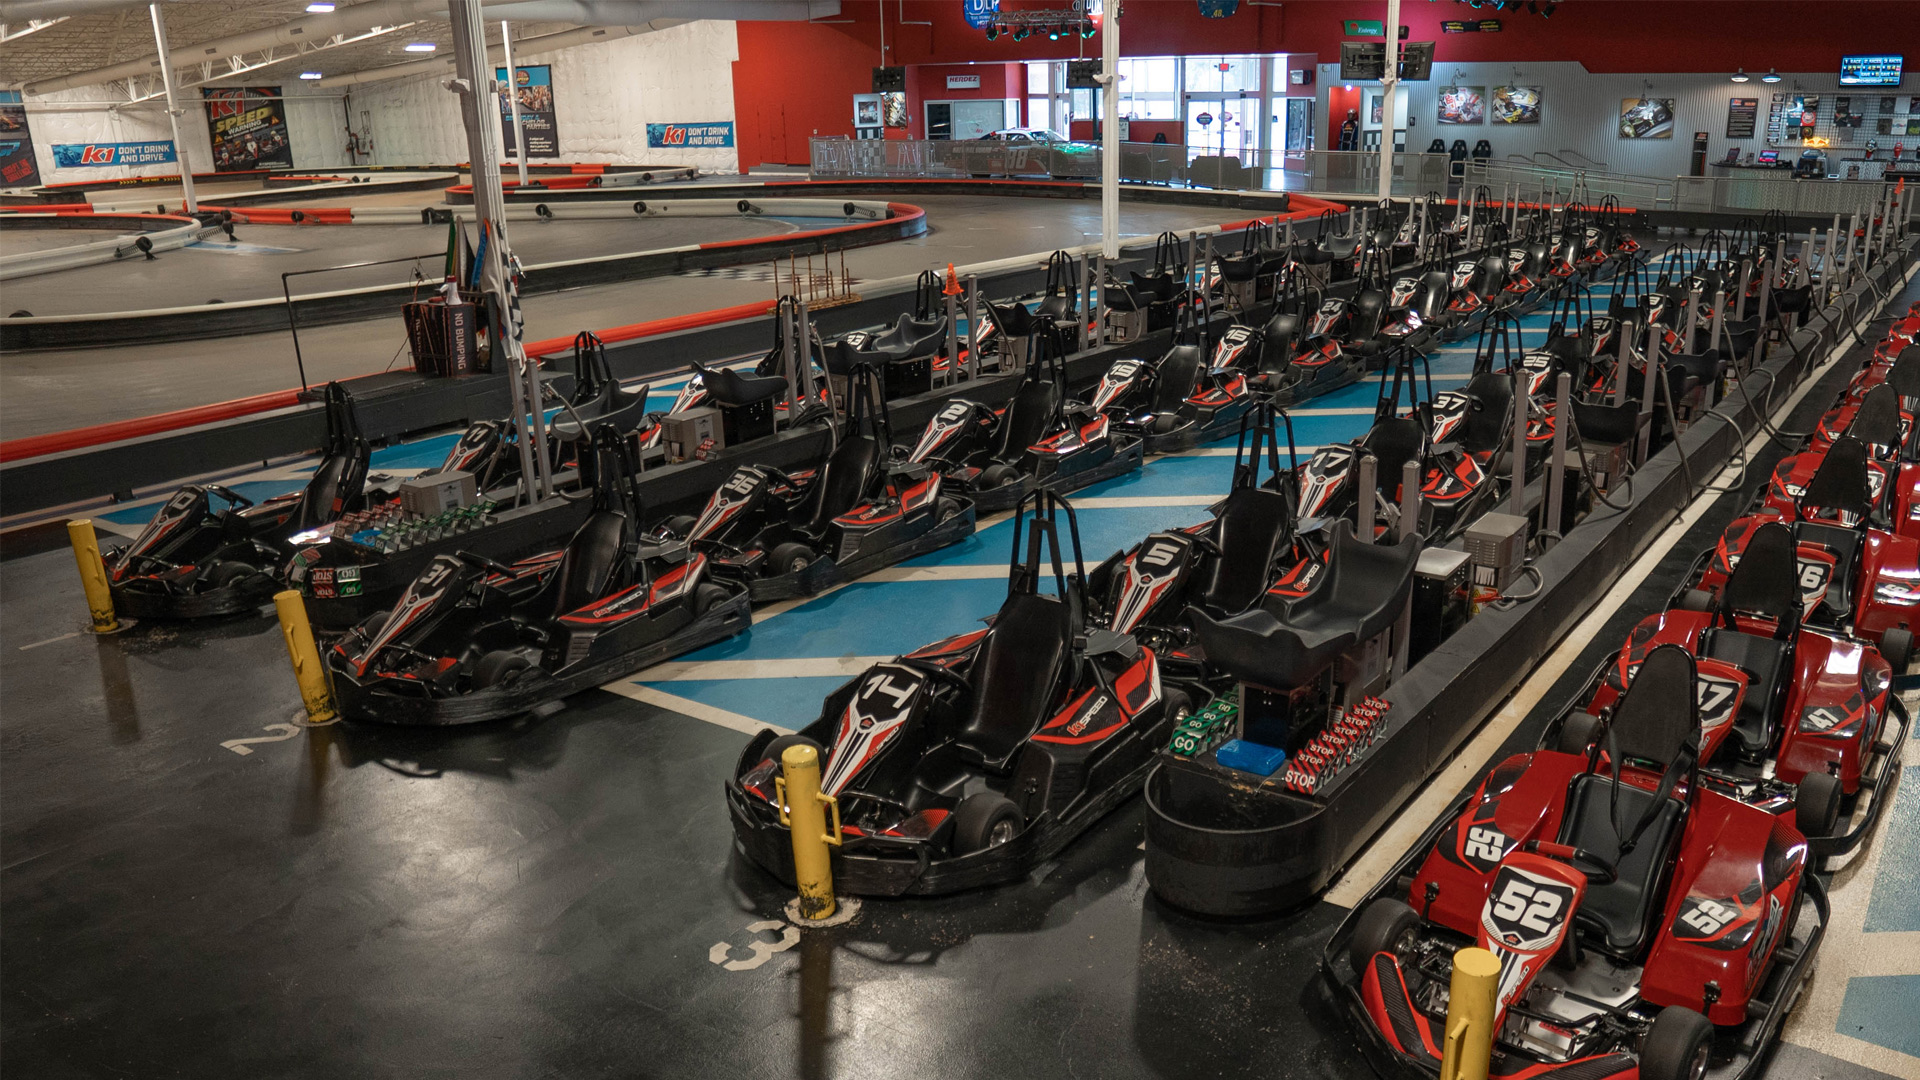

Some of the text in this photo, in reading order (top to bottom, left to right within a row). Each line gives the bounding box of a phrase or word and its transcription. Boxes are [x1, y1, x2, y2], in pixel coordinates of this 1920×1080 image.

[208, 90, 245, 120] K1
[216, 107, 274, 132] SPEED
[228, 120, 261, 135] WARNING
[662, 125, 686, 144] K1
[688, 127, 729, 136] DON'T DRINK
[688, 137, 702, 145] AND
[81, 145, 115, 164] K1
[118, 145, 170, 155] DON'T DRINK
[120, 153, 166, 163] AND DRIVE.
[1457, 264, 1474, 272] 12
[1321, 301, 1342, 312] 24
[455, 313, 466, 370] NO BUMPING
[1225, 329, 1250, 342] 16
[1523, 356, 1552, 367] 25
[1110, 364, 1137, 377] 19
[1433, 396, 1466, 410] 37
[941, 404, 968, 421] 2
[467, 426, 489, 443] 11
[1313, 452, 1351, 468] 17
[724, 472, 759, 494] 36
[168, 492, 197, 510] 10
[376, 540, 384, 549] GO
[1142, 543, 1180, 566] 5
[420, 564, 452, 587] 31
[1798, 564, 1824, 589] 6
[593, 590, 643, 618] K1SPEED
[862, 674, 919, 709] 14
[1218, 703, 1231, 713] GO
[1364, 699, 1387, 710] STOP
[1067, 695, 1108, 736] K1SPEED
[1203, 712, 1216, 721] GO
[1354, 708, 1377, 718] STOP
[1808, 708, 1839, 729] 47
[1189, 720, 1202, 729] GO
[1345, 716, 1368, 727] STOP
[1334, 726, 1358, 737] STOP
[220, 723, 300, 756] 2
[1174, 736, 1194, 751] GO
[1322, 734, 1346, 745] STOP
[1310, 744, 1334, 756] STOP
[1298, 753, 1323, 765] STOP
[1285, 770, 1315, 788] STOP
[1465, 827, 1505, 862] 52
[1493, 879, 1562, 934] 52
[1681, 900, 1737, 935] 52
[709, 920, 800, 971] 3
